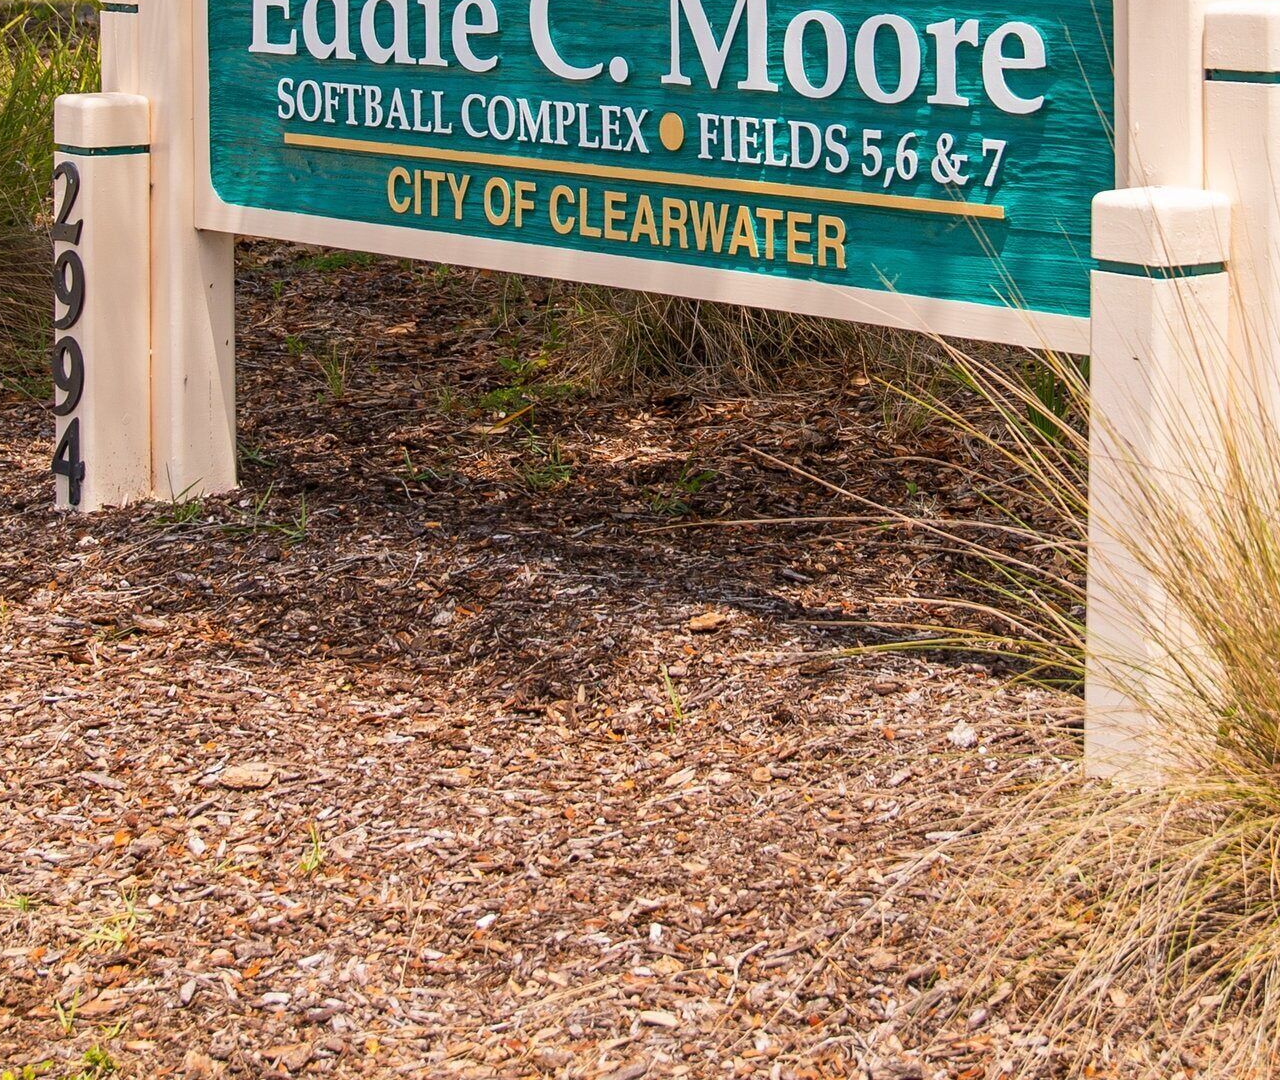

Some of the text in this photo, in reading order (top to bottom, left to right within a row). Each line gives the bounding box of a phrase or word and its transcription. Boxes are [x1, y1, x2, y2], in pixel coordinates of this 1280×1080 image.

[277, 77, 1007, 189] SOFTBALL COMPLEX FIELDS 5,6 & 7
[386, 165, 847, 270] CITY OF CLEARWATER
[51, 160, 86, 507] 2994
